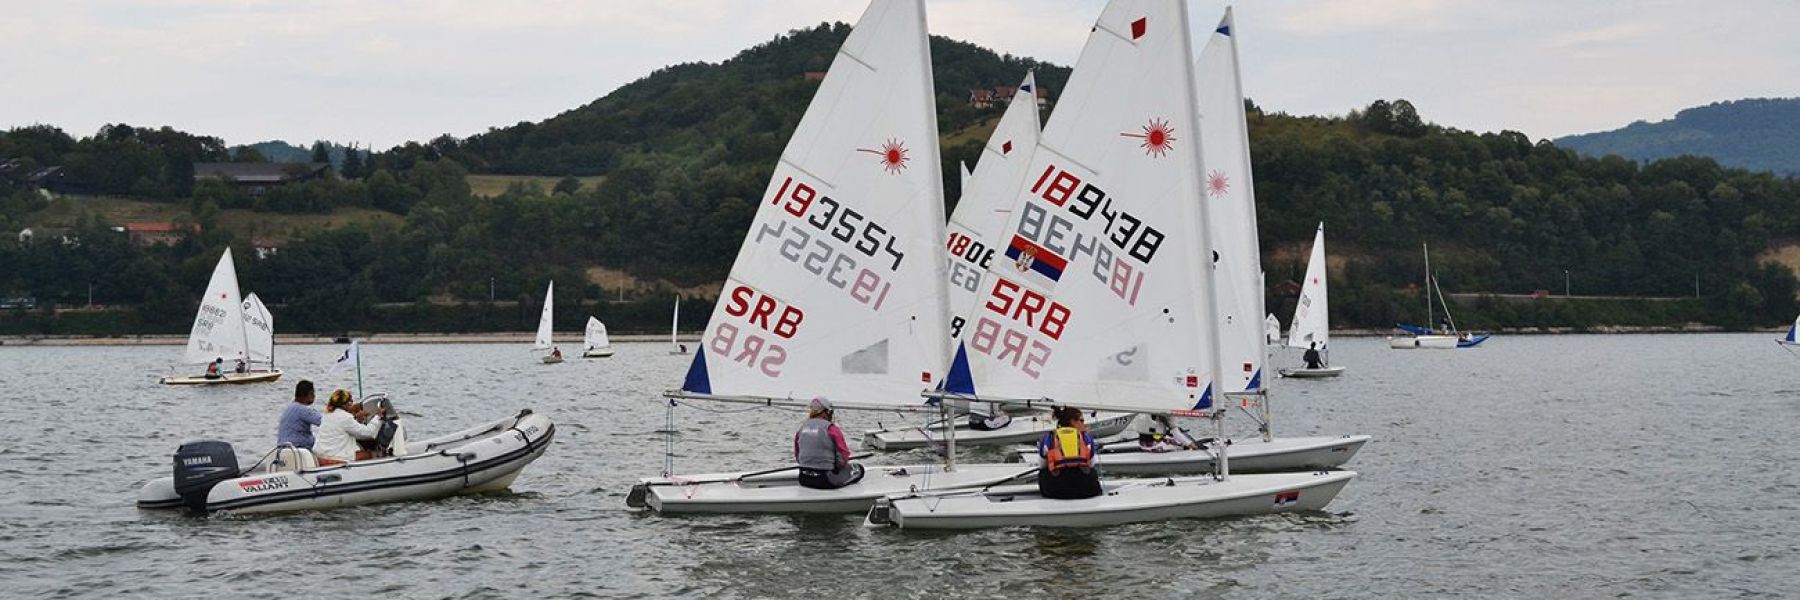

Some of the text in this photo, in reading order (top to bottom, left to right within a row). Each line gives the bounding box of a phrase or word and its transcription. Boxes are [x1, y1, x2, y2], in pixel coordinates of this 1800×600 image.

[772, 177, 904, 271] 193554
[1030, 164, 1165, 264] 189438
[725, 286, 804, 339] SRB
[985, 278, 1072, 341] SRB
[183, 456, 212, 465] YAMAHA
